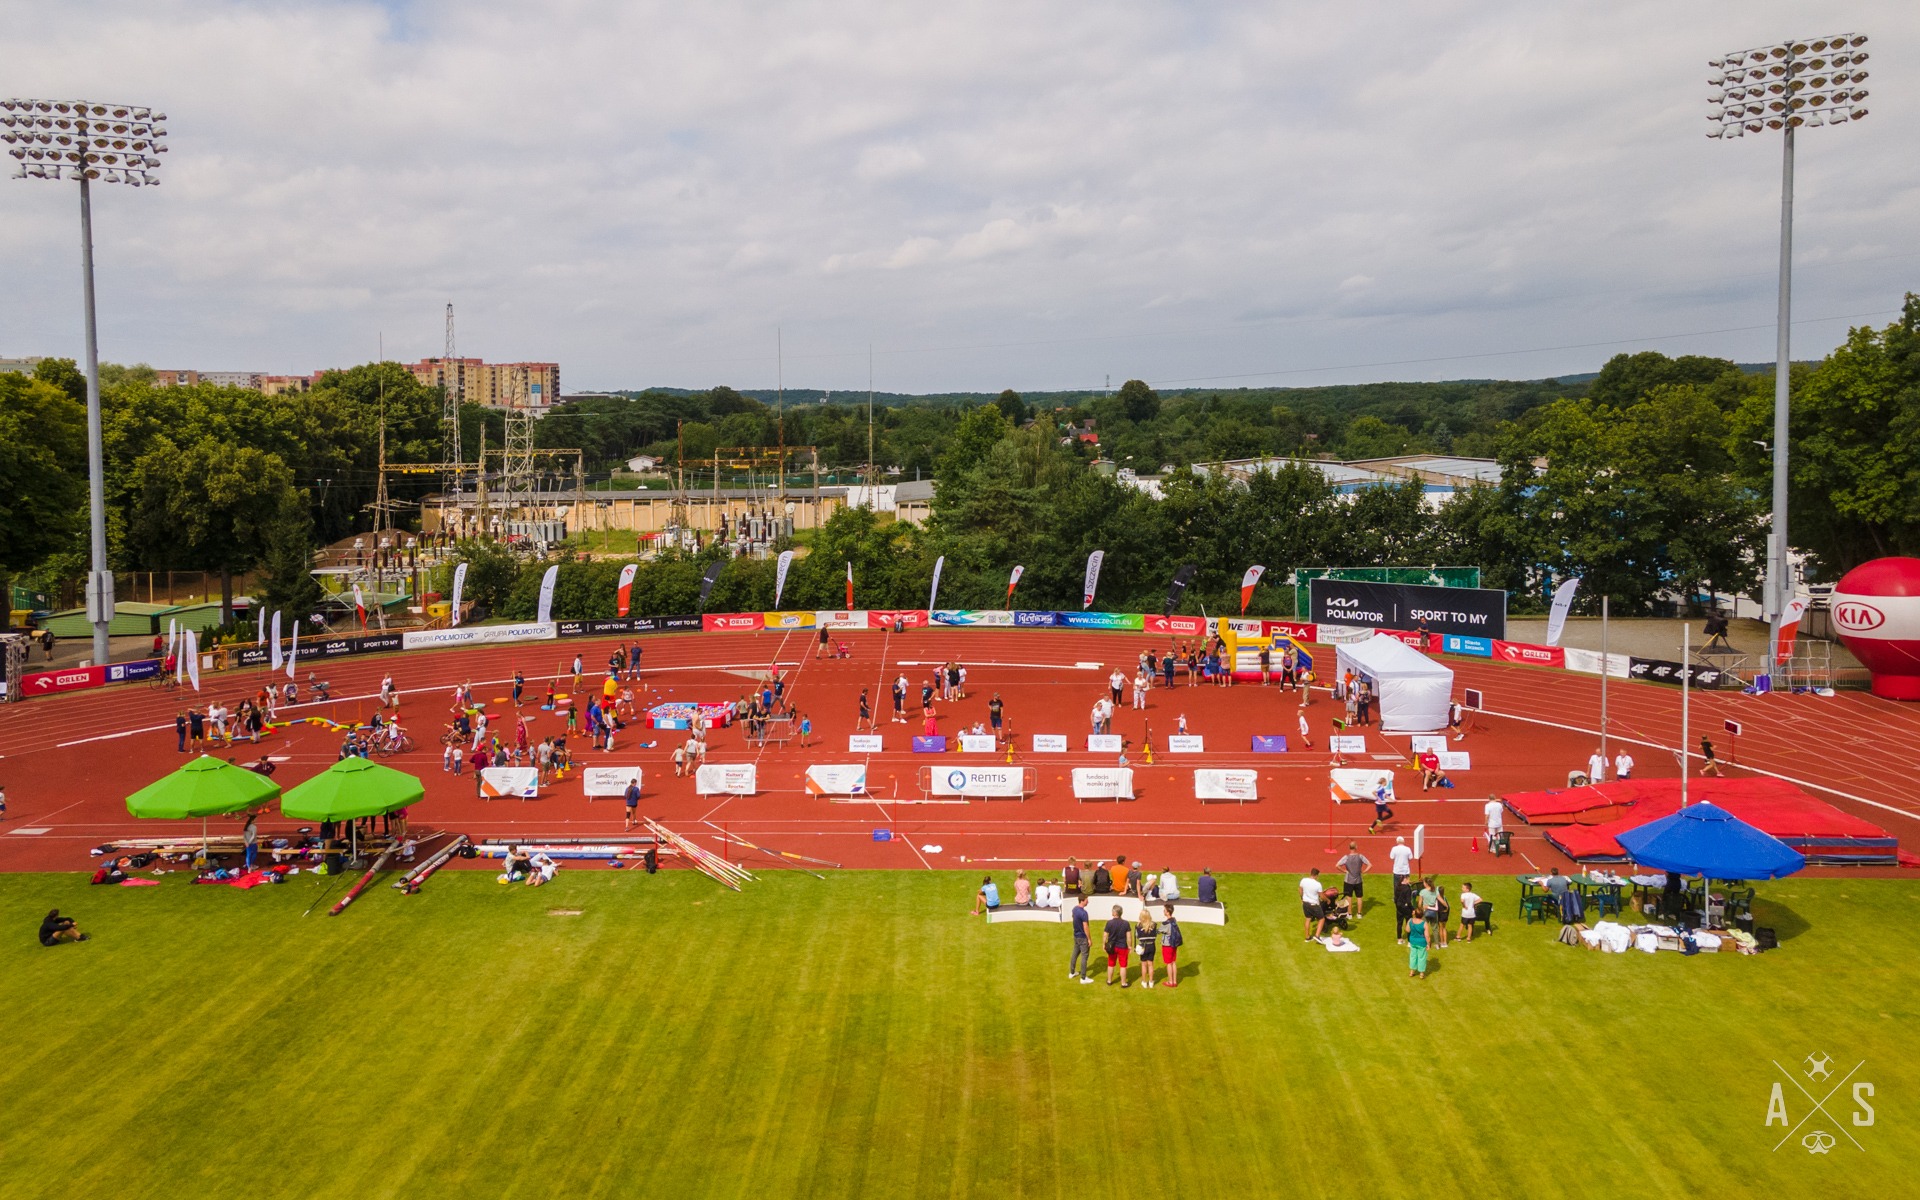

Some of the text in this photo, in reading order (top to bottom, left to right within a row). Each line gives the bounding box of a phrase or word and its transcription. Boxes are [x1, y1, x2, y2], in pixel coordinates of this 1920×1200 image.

[1068, 617, 1132, 625] www.szczecin.eu
[1327, 609, 1383, 622] POLMOTOR
[1410, 609, 1488, 625] SPORT TO MY
[1838, 607, 1873, 626] KIA
[1172, 622, 1194, 630] ORLEN
[434, 632, 474, 642] POLMOTOR
[484, 627, 546, 638] GRUPA POLMOTOR
[1524, 650, 1549, 660] ORLEN
[1631, 663, 1650, 674] 4F
[1652, 666, 1672, 677] 4F
[58, 674, 88, 684] ORLEN
[1696, 671, 1719, 683] 4F
